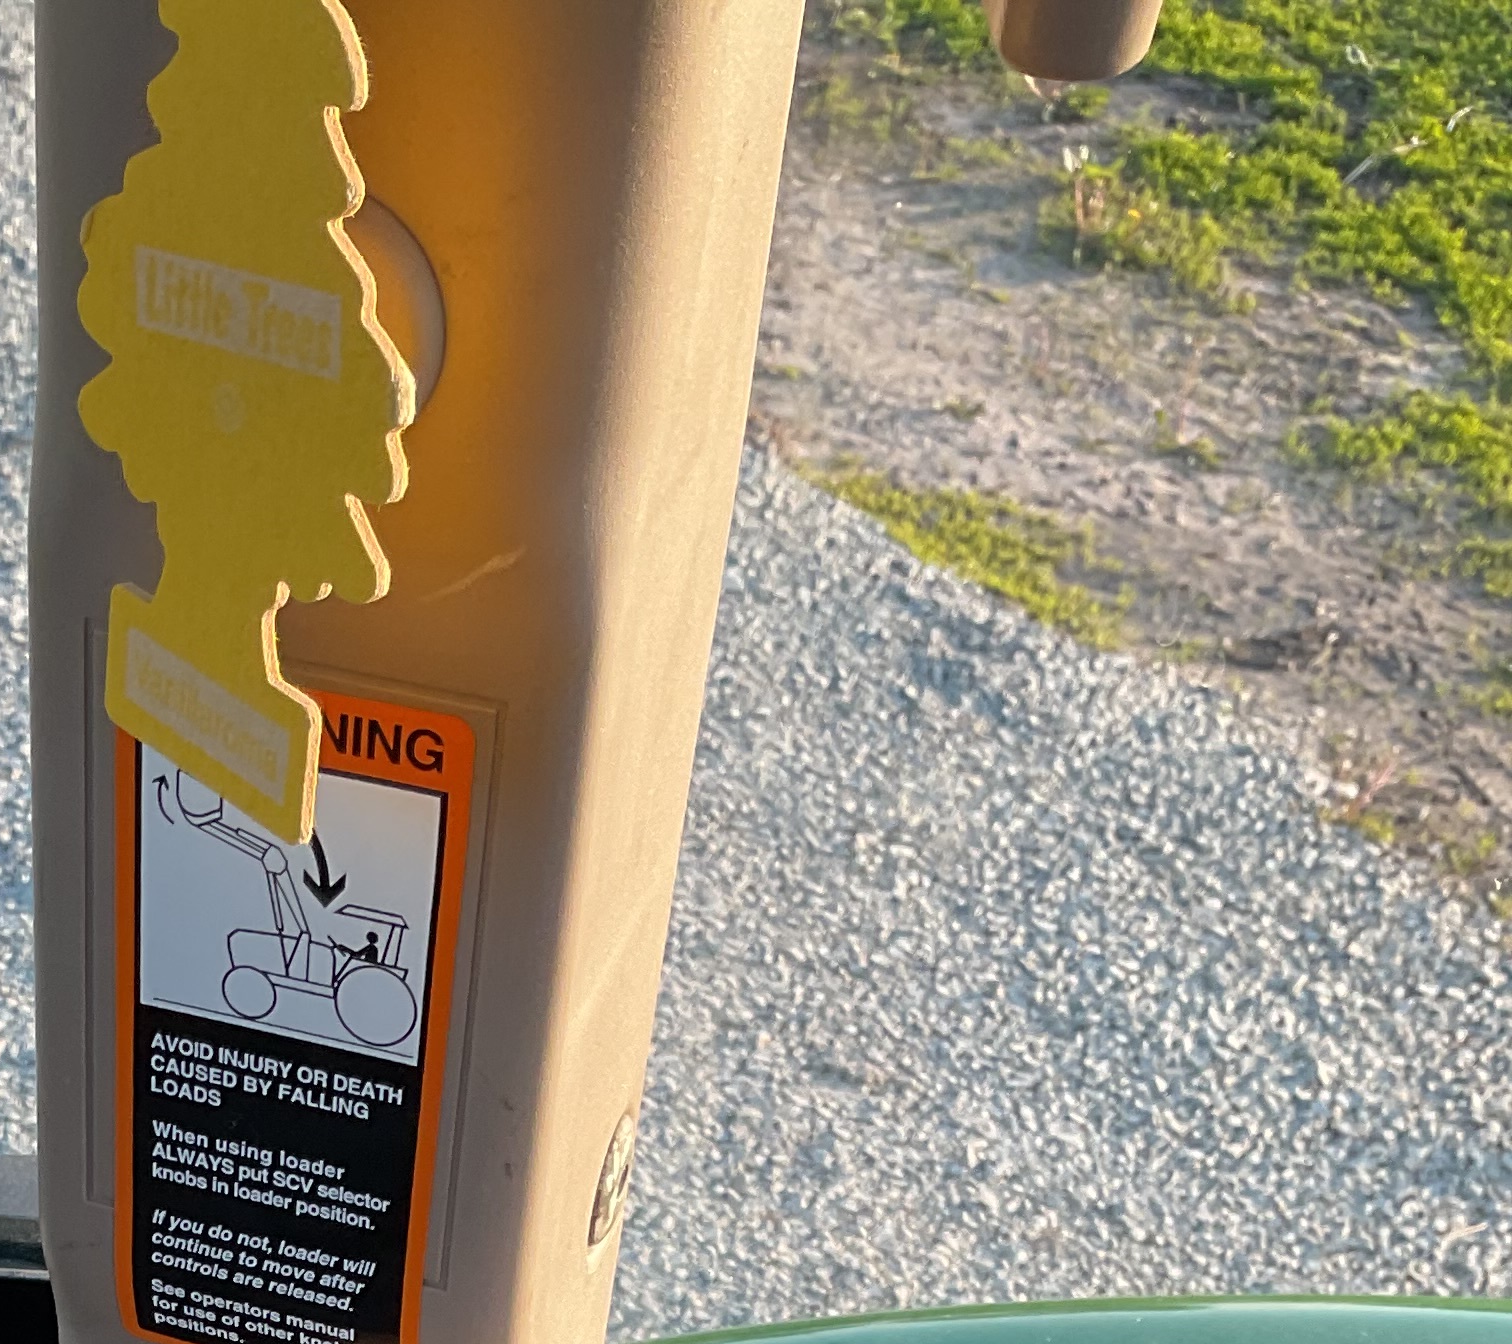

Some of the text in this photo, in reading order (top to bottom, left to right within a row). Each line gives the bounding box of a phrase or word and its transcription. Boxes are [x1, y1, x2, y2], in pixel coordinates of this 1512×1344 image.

[145, 255, 333, 369] Little Trees
[321, 706, 445, 774] NING
[151, 1032, 403, 1105] AVOID INJURY OR DEATH
[151, 1055, 369, 1119] CAUSED BY FALLING
[151, 1075, 222, 1107] LOADS
[152, 1119, 345, 1180] When using loader
[152, 1142, 391, 1212] ALWAYS put SCV selector
[152, 1162, 376, 1231] knobs in loader position.
[151, 1208, 377, 1277] If you do not, loader will
[151, 1232, 365, 1294] continue to move after
[151, 1251, 354, 1312] controls are released.
[151, 1278, 355, 1342] See operators manual
[151, 1295, 179, 1312] for
[183, 1304, 217, 1322] use
[221, 1314, 240, 1328] of
[244, 1320, 295, 1341] other
[153, 1311, 245, 1344] positions.
